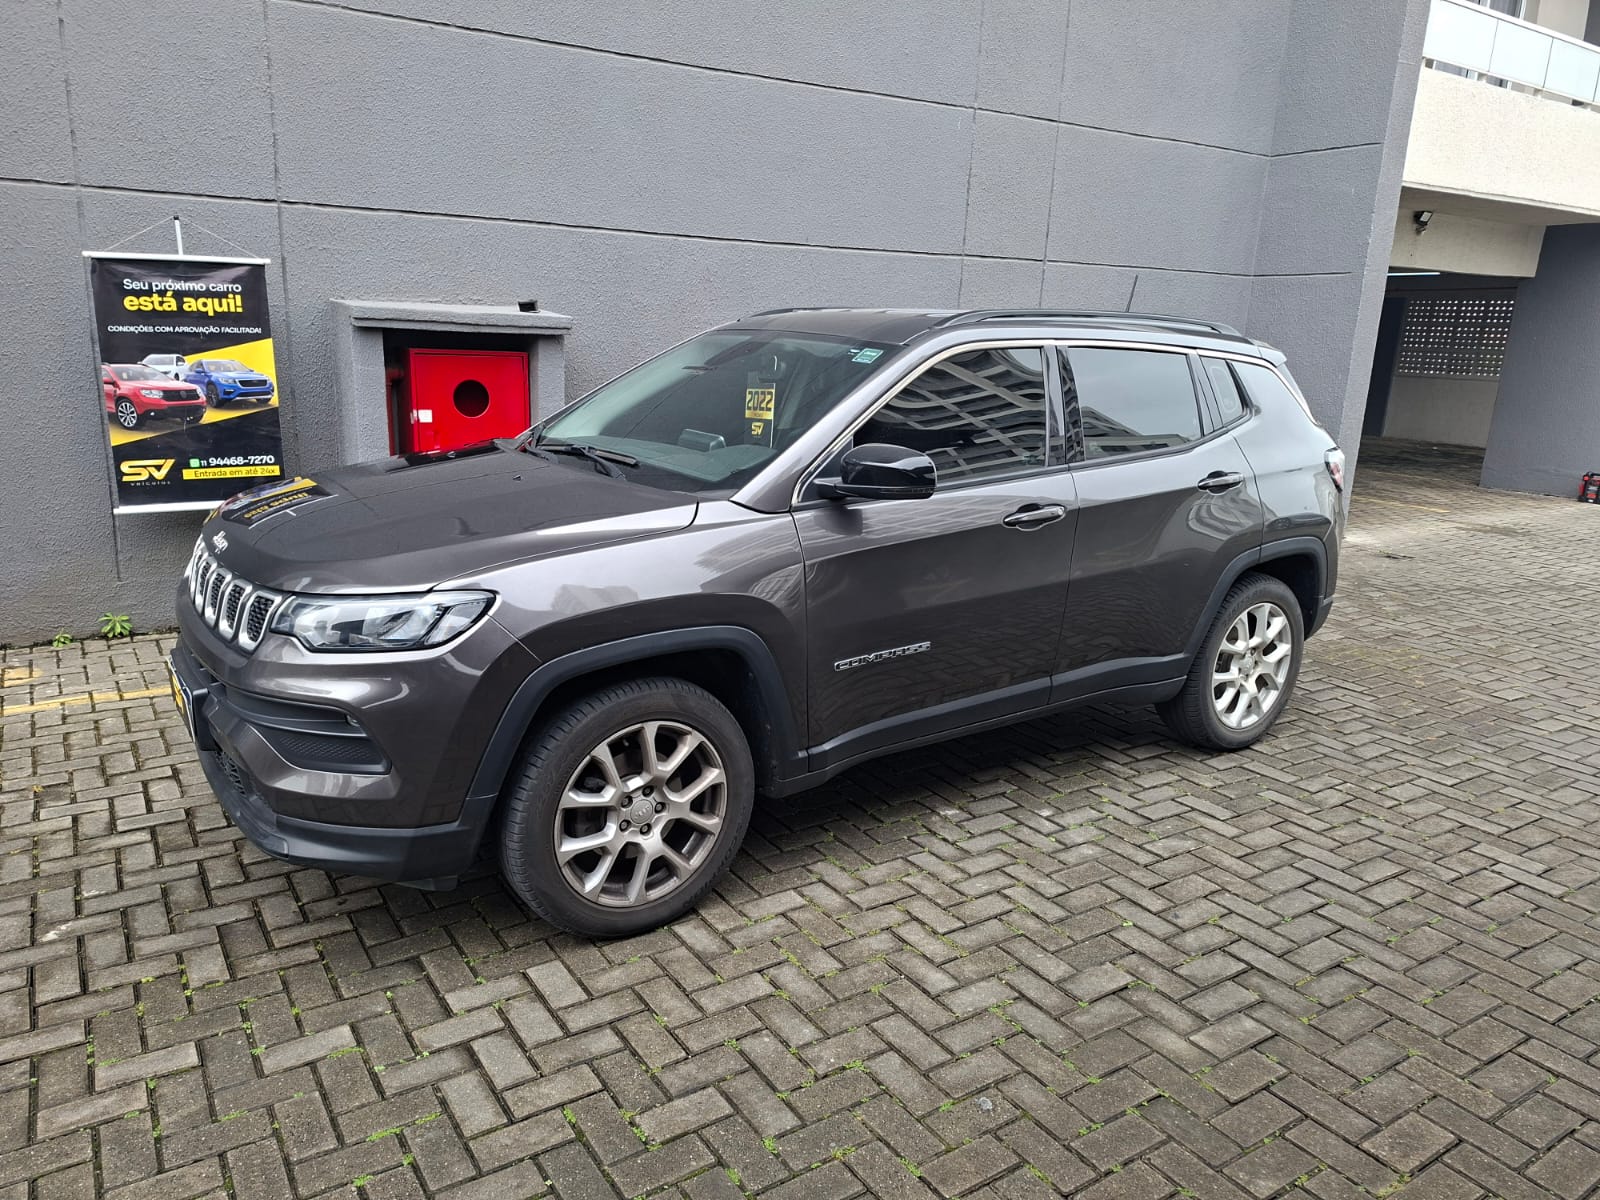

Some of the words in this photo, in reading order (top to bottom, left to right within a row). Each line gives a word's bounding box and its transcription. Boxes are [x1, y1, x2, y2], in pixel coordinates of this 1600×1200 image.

[123, 278, 149, 290] Seu
[152, 279, 206, 292] próximo
[208, 282, 242, 292] carro
[123, 291, 177, 311] está
[182, 293, 243, 316] aqui!
[107, 325, 154, 334] CONDIÇÕES
[174, 325, 220, 334] APROVAÇÃO
[747, 390, 773, 411] 2022
[208, 455, 275, 467] 94468-7270
[119, 458, 176, 482] SV
[194, 469, 228, 478] Entrada
[244, 467, 259, 476] até
[260, 467, 276, 475] 24x
[834, 641, 931, 671] COMPASS
